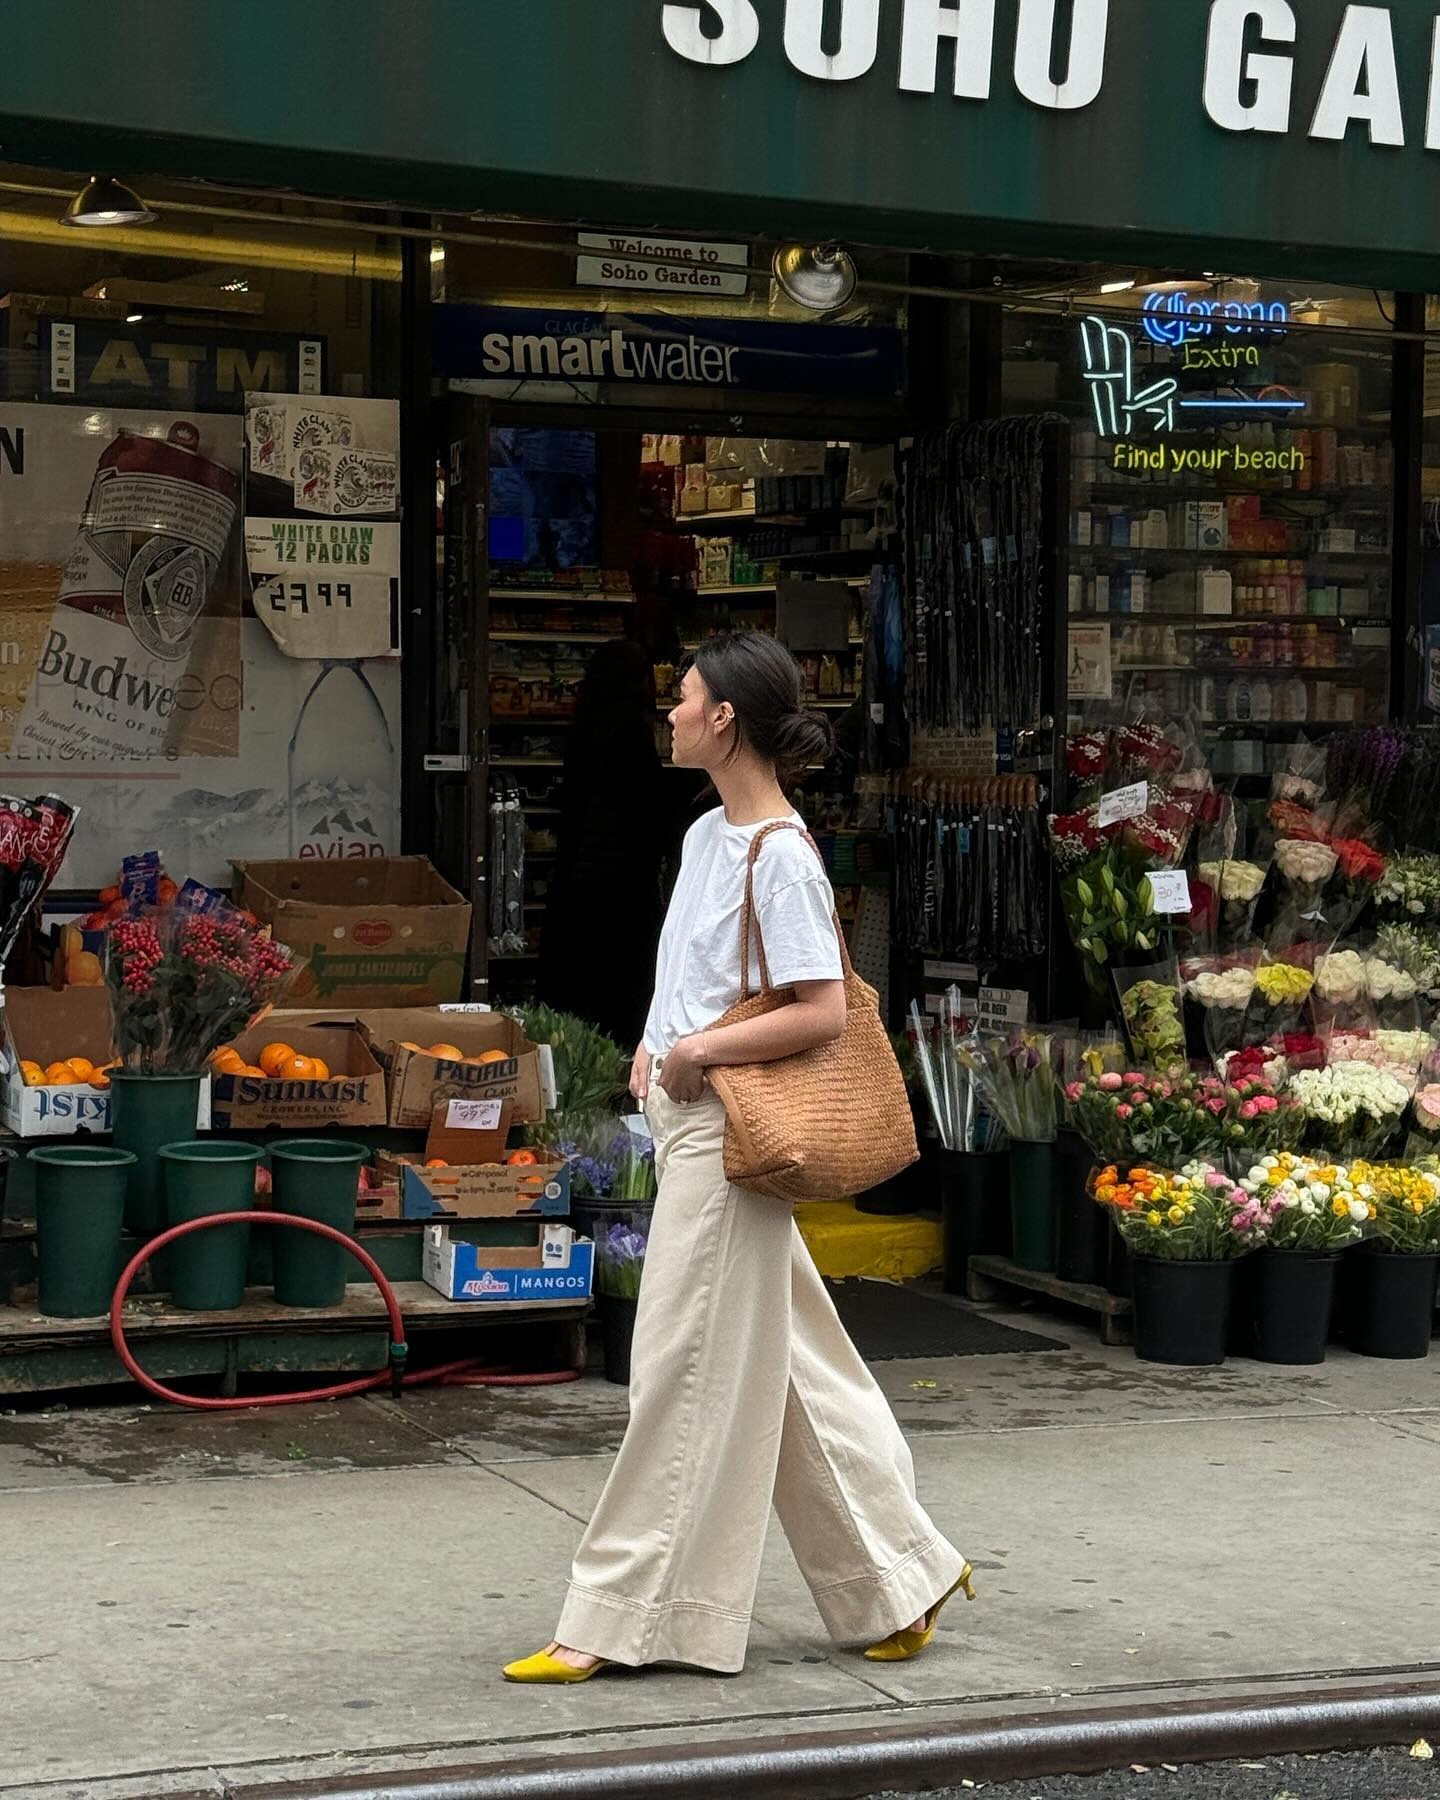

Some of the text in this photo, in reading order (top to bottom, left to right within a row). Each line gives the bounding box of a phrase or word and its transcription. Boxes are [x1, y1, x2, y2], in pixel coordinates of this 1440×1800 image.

[1204, 0, 1440, 150] GA
[608, 238, 720, 262] Welcome to
[601, 261, 722, 287] Soho Garden
[1142, 292, 1289, 345] Corona
[89, 338, 286, 393] ATM
[1182, 339, 1259, 370] Extra
[1112, 444, 1306, 472] Find your beach
[272, 523, 374, 544] WHITE CLAW
[274, 542, 297, 562] 12
[306, 544, 371, 564] PACKS
[72, 698, 118, 723] KING
[125, 718, 147, 732] OF
[299, 836, 385, 859] evian
[433, 1056, 519, 1081] PACIFICO
[240, 1076, 369, 1106] Sunkist
[521, 1276, 585, 1290] MANGOS
